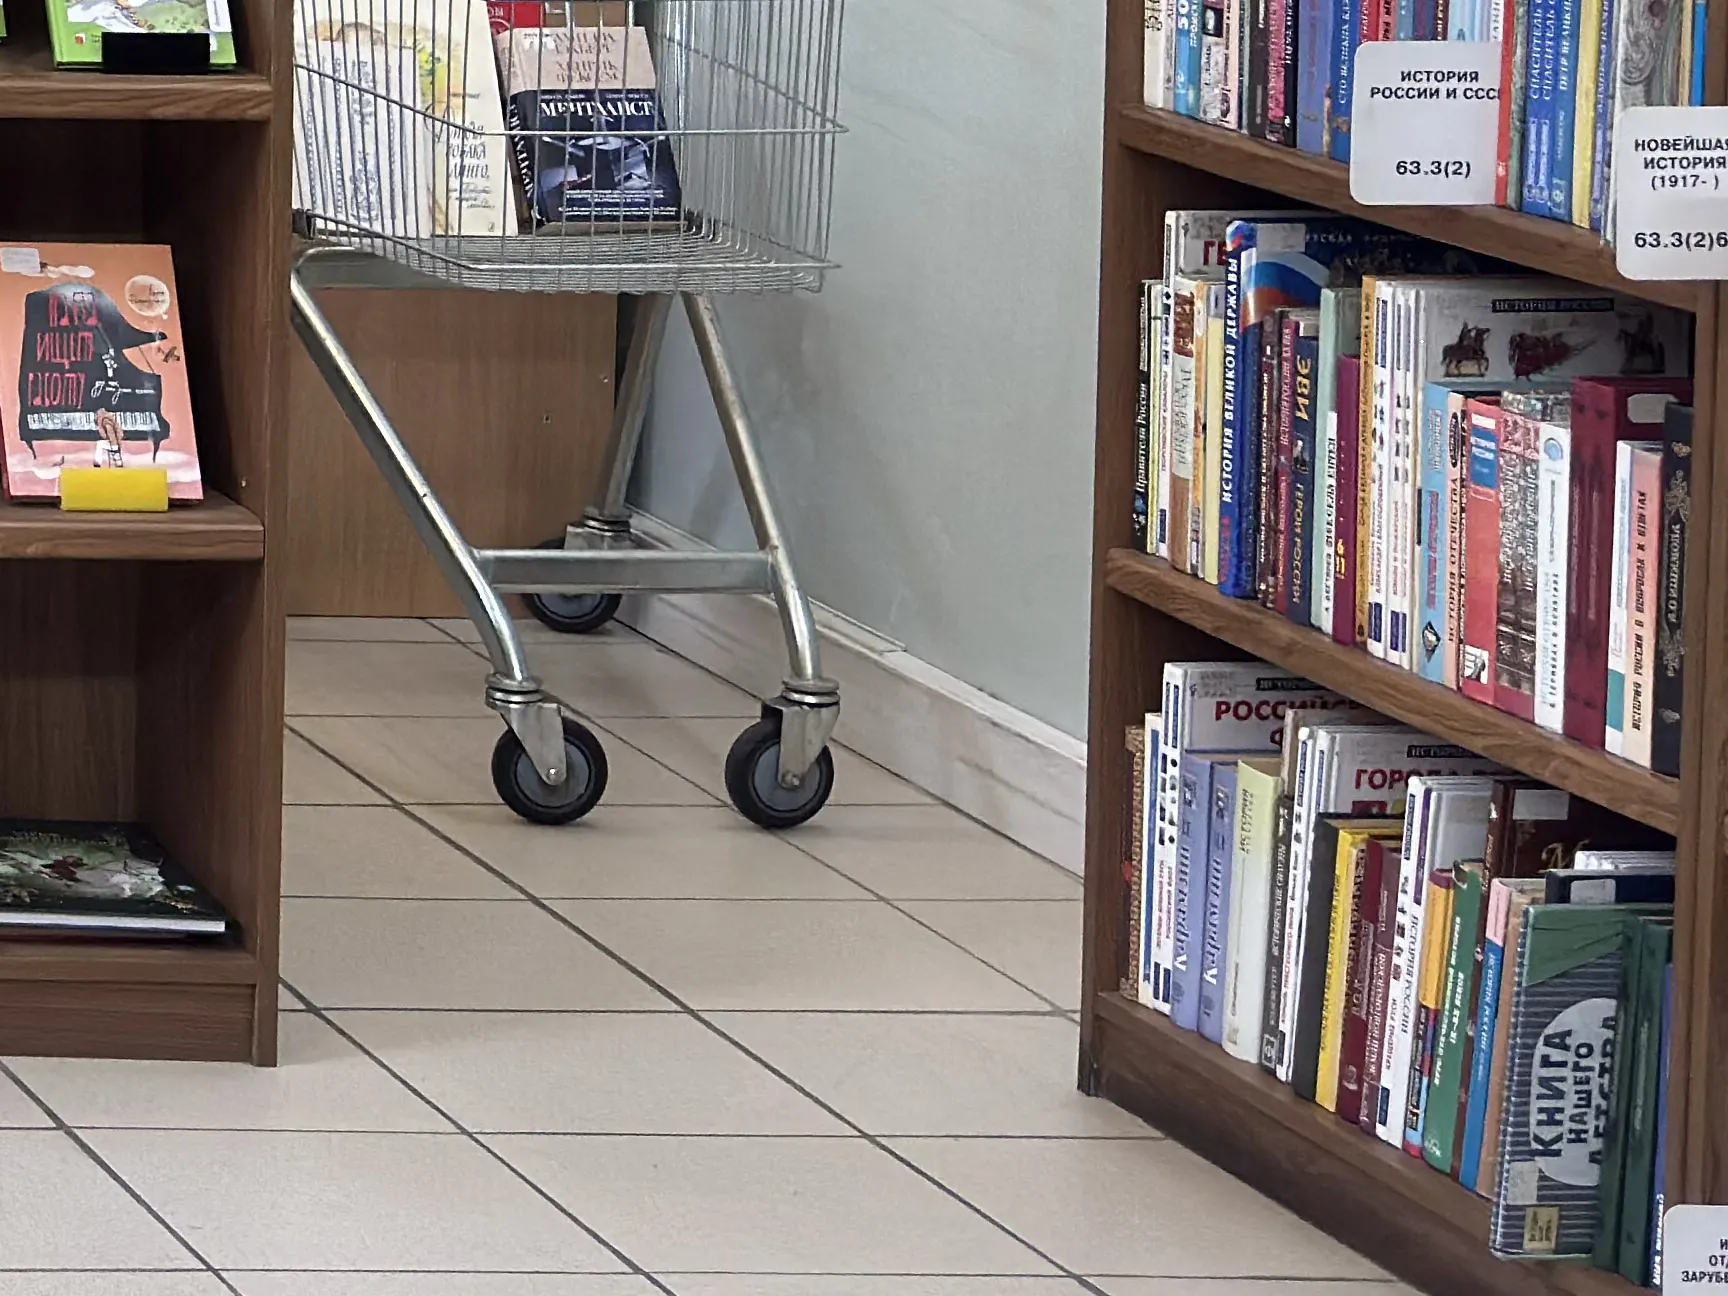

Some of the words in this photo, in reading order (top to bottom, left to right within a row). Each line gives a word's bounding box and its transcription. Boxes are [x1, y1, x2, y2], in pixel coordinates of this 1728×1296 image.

[1369, 85, 1440, 101] РОССИИ
[1446, 86, 1457, 100] И
[1399, 69, 1479, 84] ИСТОРИЯ
[1395, 158, 1472, 179] 63.3(2)
[1643, 156, 1727, 170] ИСТОРИЯ
[1225, 257, 1240, 339] ДЕРЖАВЫ
[1223, 344, 1238, 421] ВЕЛИКОЙ
[1222, 427, 1235, 503] ИСТОРИЯ
[1531, 1028, 1573, 1158] КНИГА
[1566, 1042, 1595, 1145] НАШЕГО
